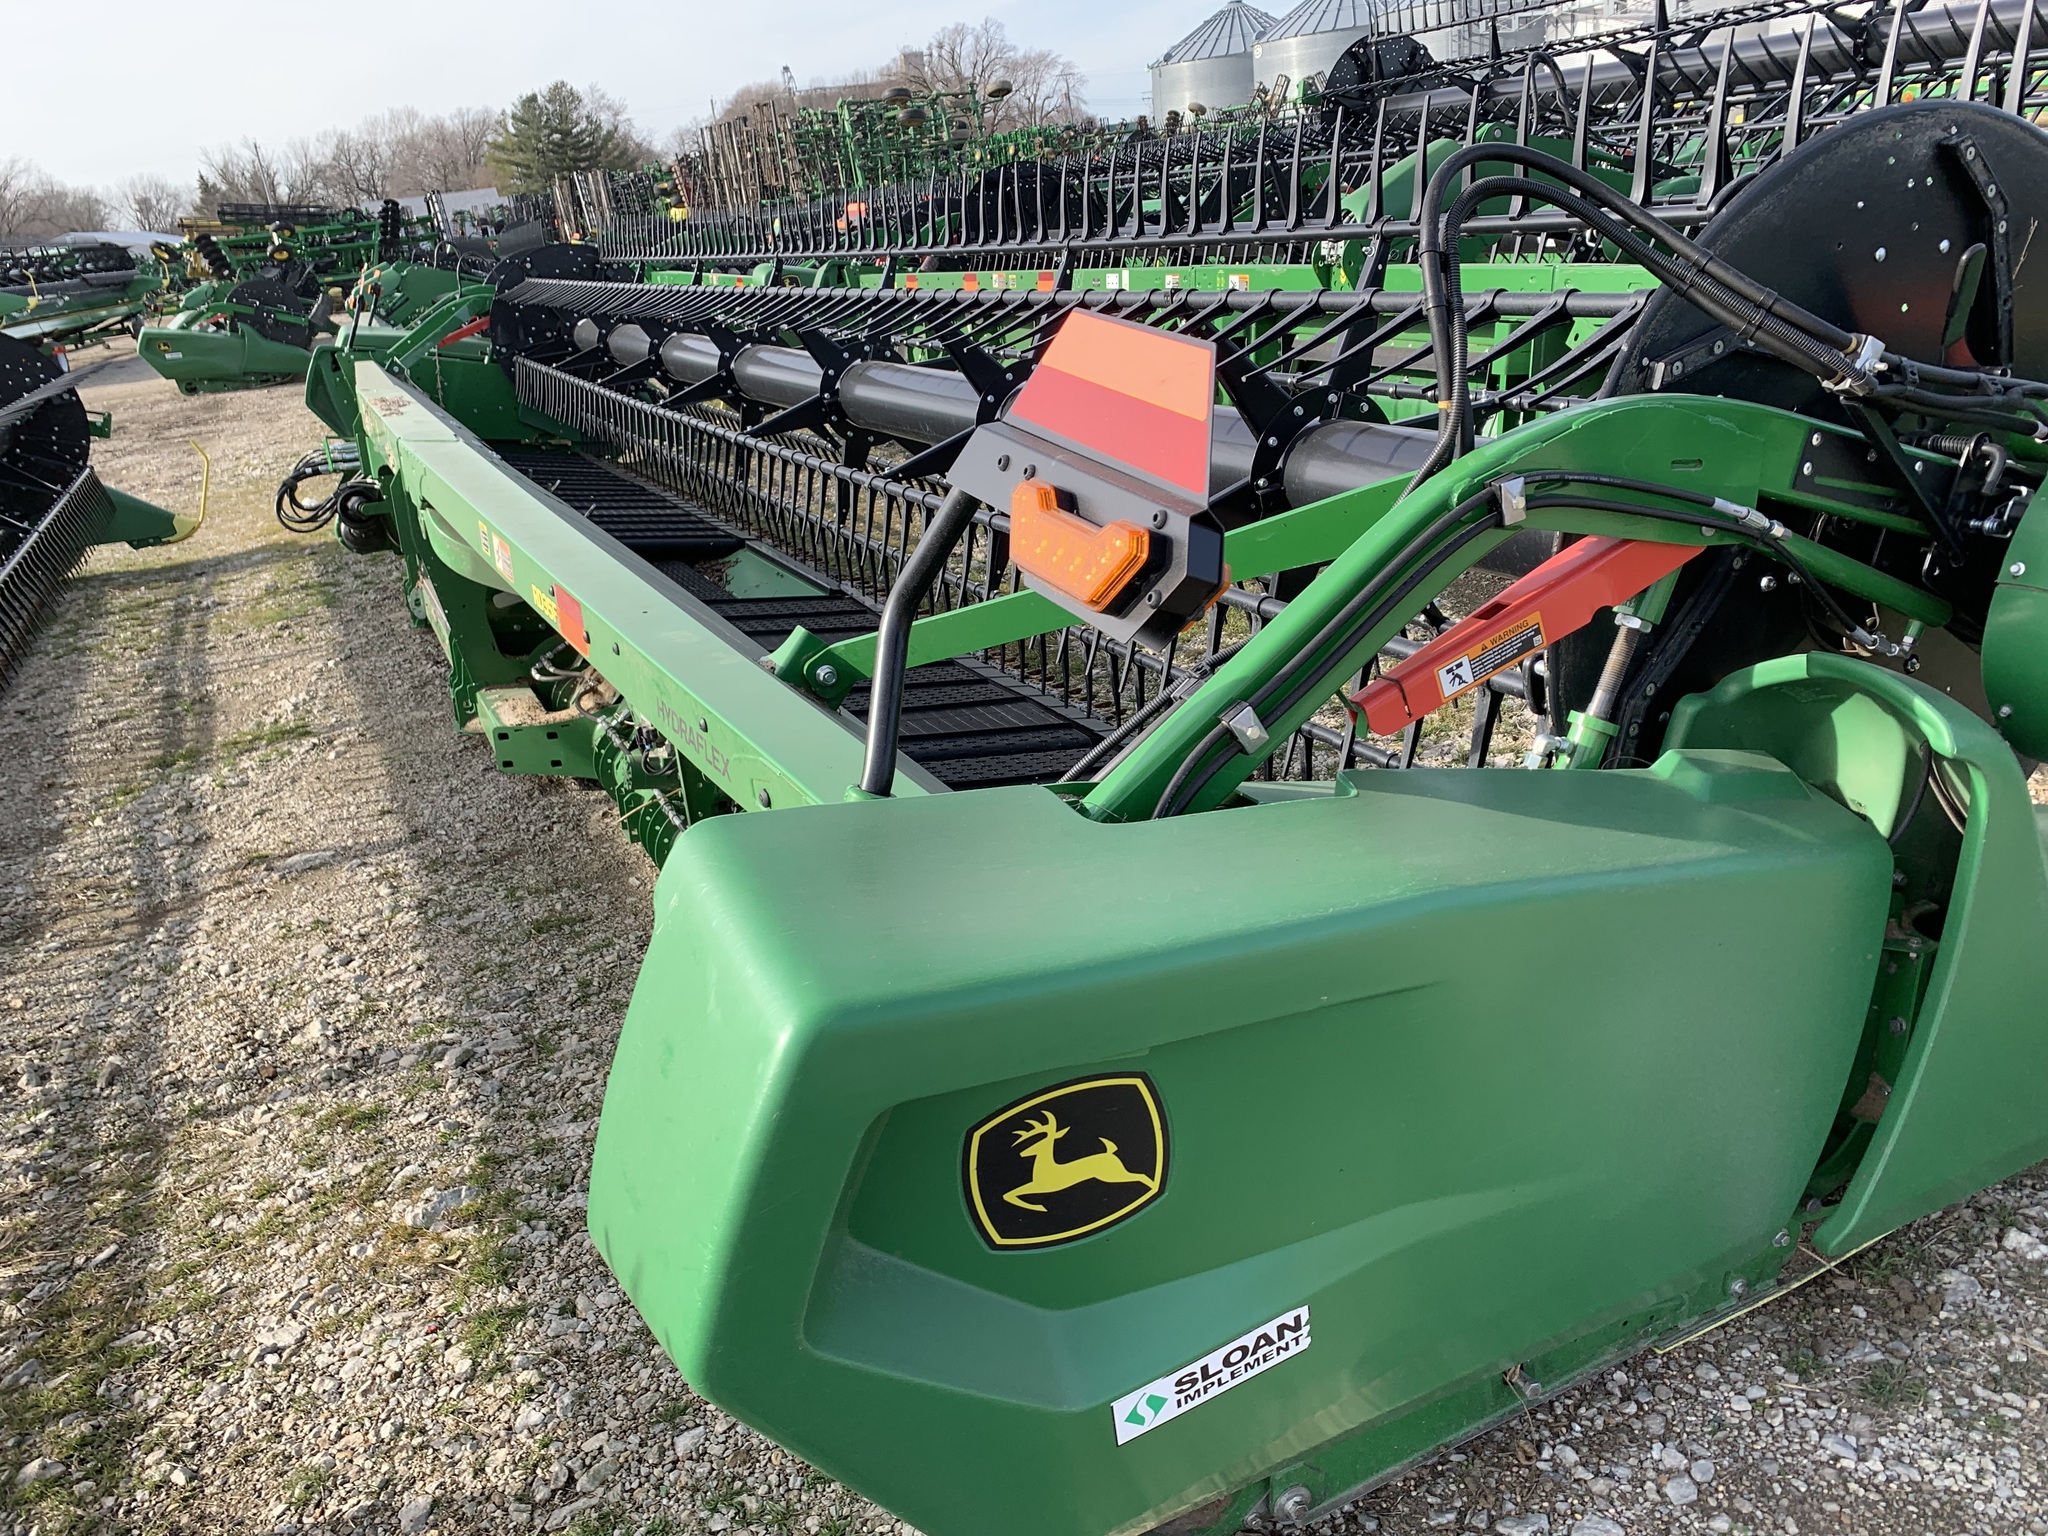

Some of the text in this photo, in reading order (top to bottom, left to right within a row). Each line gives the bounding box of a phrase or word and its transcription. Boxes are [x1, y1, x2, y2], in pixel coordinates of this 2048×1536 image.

[1490, 619, 1529, 646] WARNING
[657, 696, 732, 782] HYDRAFLEX
[1174, 1313, 1302, 1395] SLOAN
[1176, 1333, 1304, 1409] IMPLEMENT
